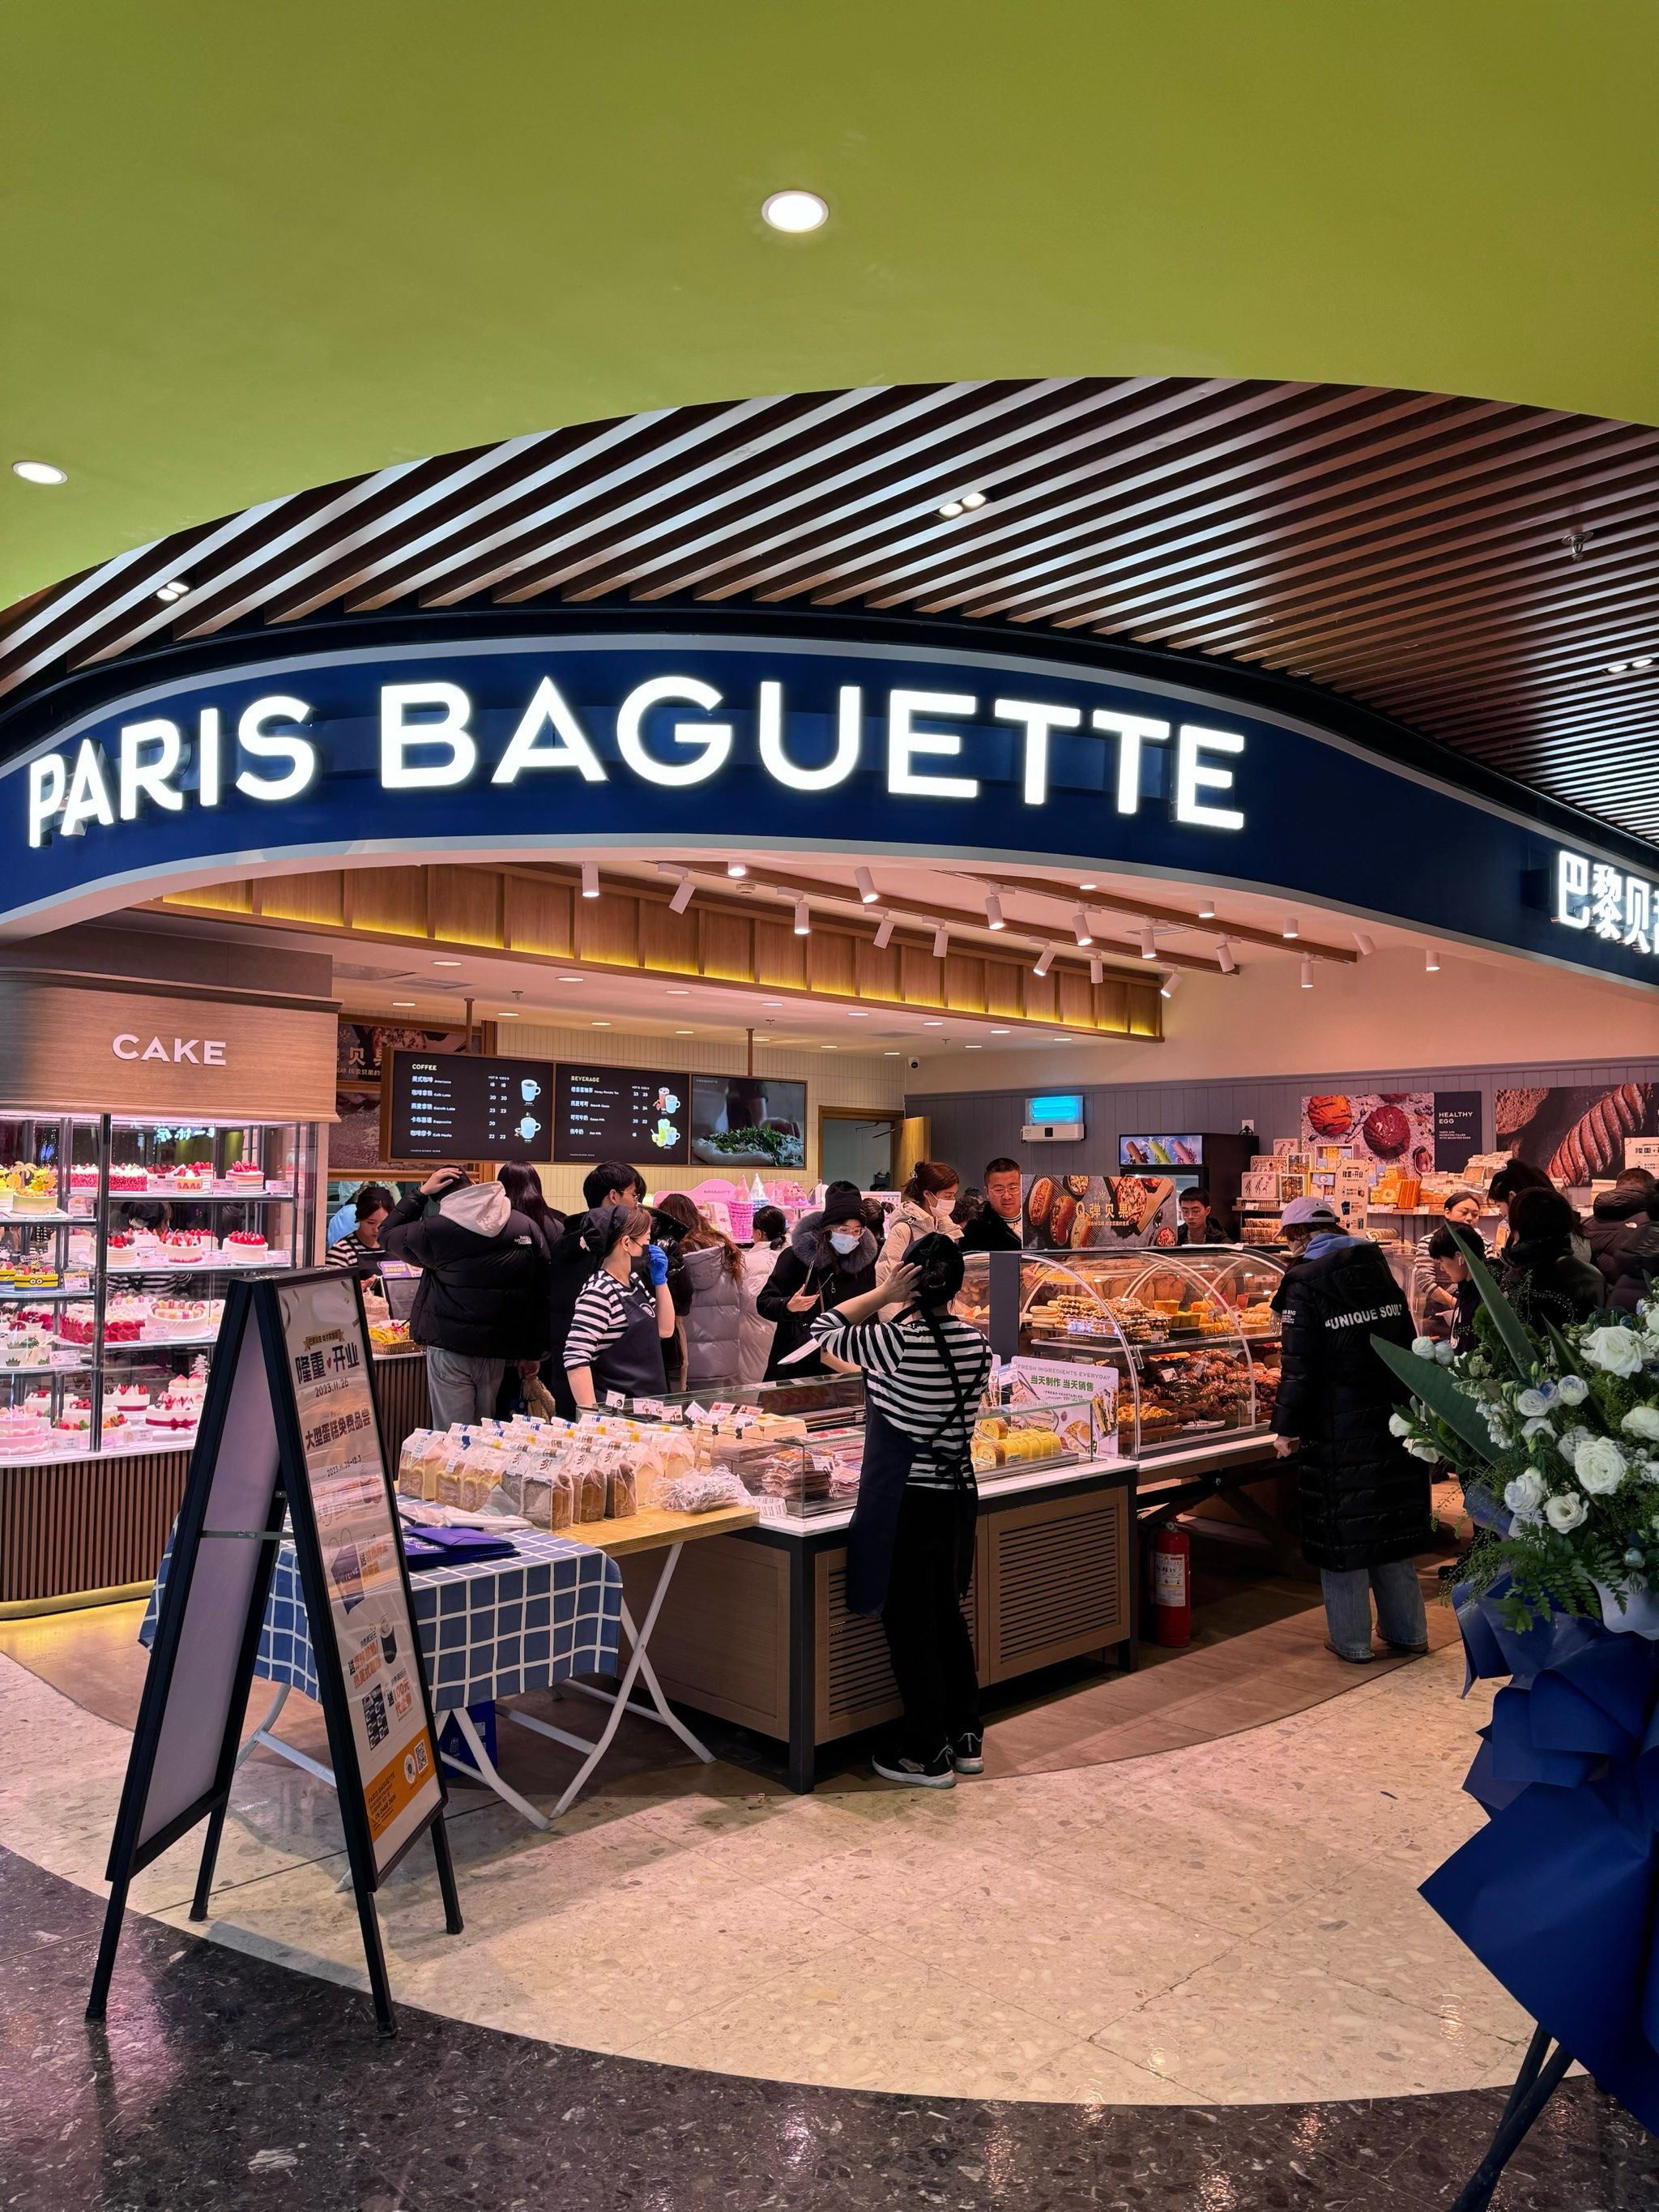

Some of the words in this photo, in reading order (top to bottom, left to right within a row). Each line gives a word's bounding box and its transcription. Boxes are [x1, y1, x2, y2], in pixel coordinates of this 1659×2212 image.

[28, 694, 316, 850] PARIS
[380, 675, 1246, 831] BAGUETTE
[1559, 851, 1659, 954] 巴黎贝
[112, 1033, 227, 1065] CAKE
[412, 1063, 437, 1071] COFFEE
[295, 1350, 326, 1385] 隆重
[331, 1342, 360, 1373] 开业
[1038, 1366, 1077, 1377] INGREDIENTS
[1078, 1371, 1111, 1380] EVERYDAY
[314, 1377, 349, 1398] 2023.11.26
[1030, 1374, 1061, 1387] 当天制作
[1062, 1378, 1094, 1392] 当天销售
[305, 1408, 371, 1451] 大型蛋糕免费品尝
